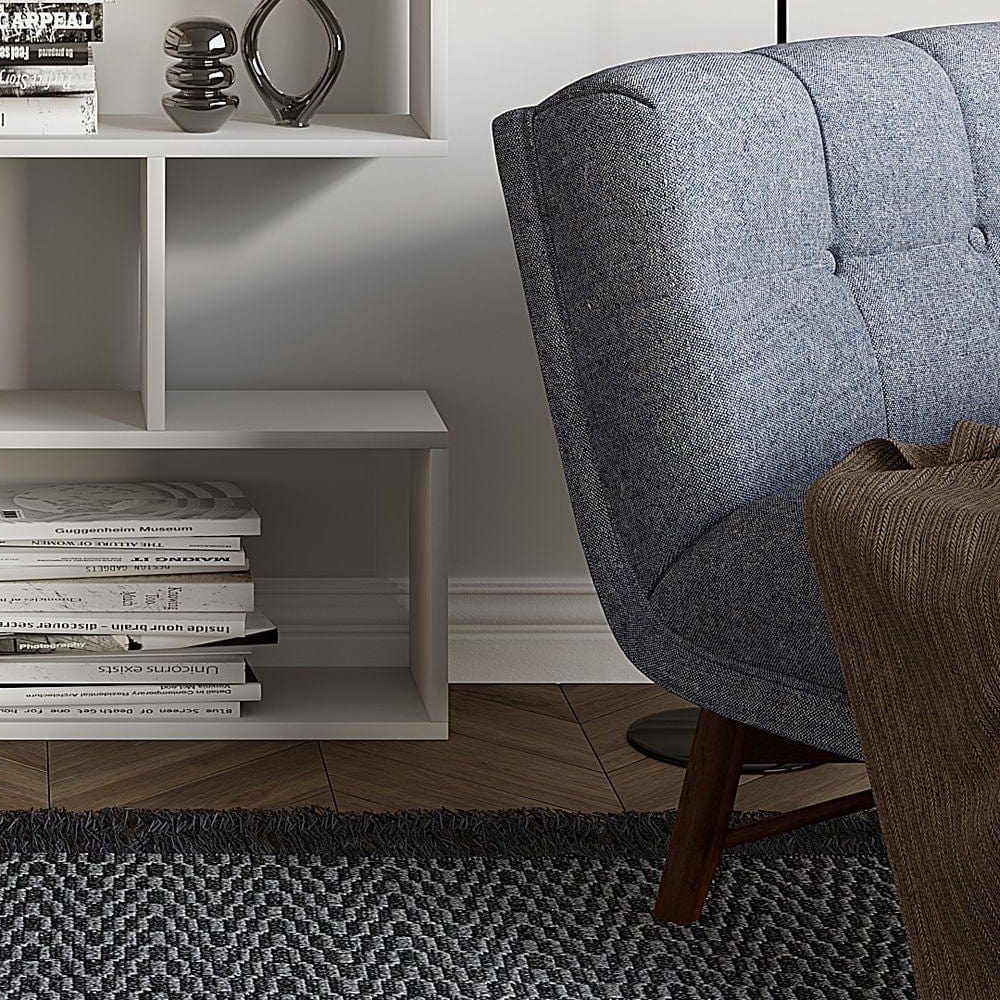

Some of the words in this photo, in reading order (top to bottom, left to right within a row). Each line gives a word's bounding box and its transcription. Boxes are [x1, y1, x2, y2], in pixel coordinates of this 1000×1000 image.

[10, 46, 29, 60] Feel
[37, 47, 65, 58] prepared
[64, 49, 74, 58] Be
[19, 640, 85, 649] Photography
[98, 666, 142, 675] exists
[147, 666, 218, 675] Unicorns
[196, 683, 231, 691] Virginia
[130, 688, 192, 696] Contemporary
